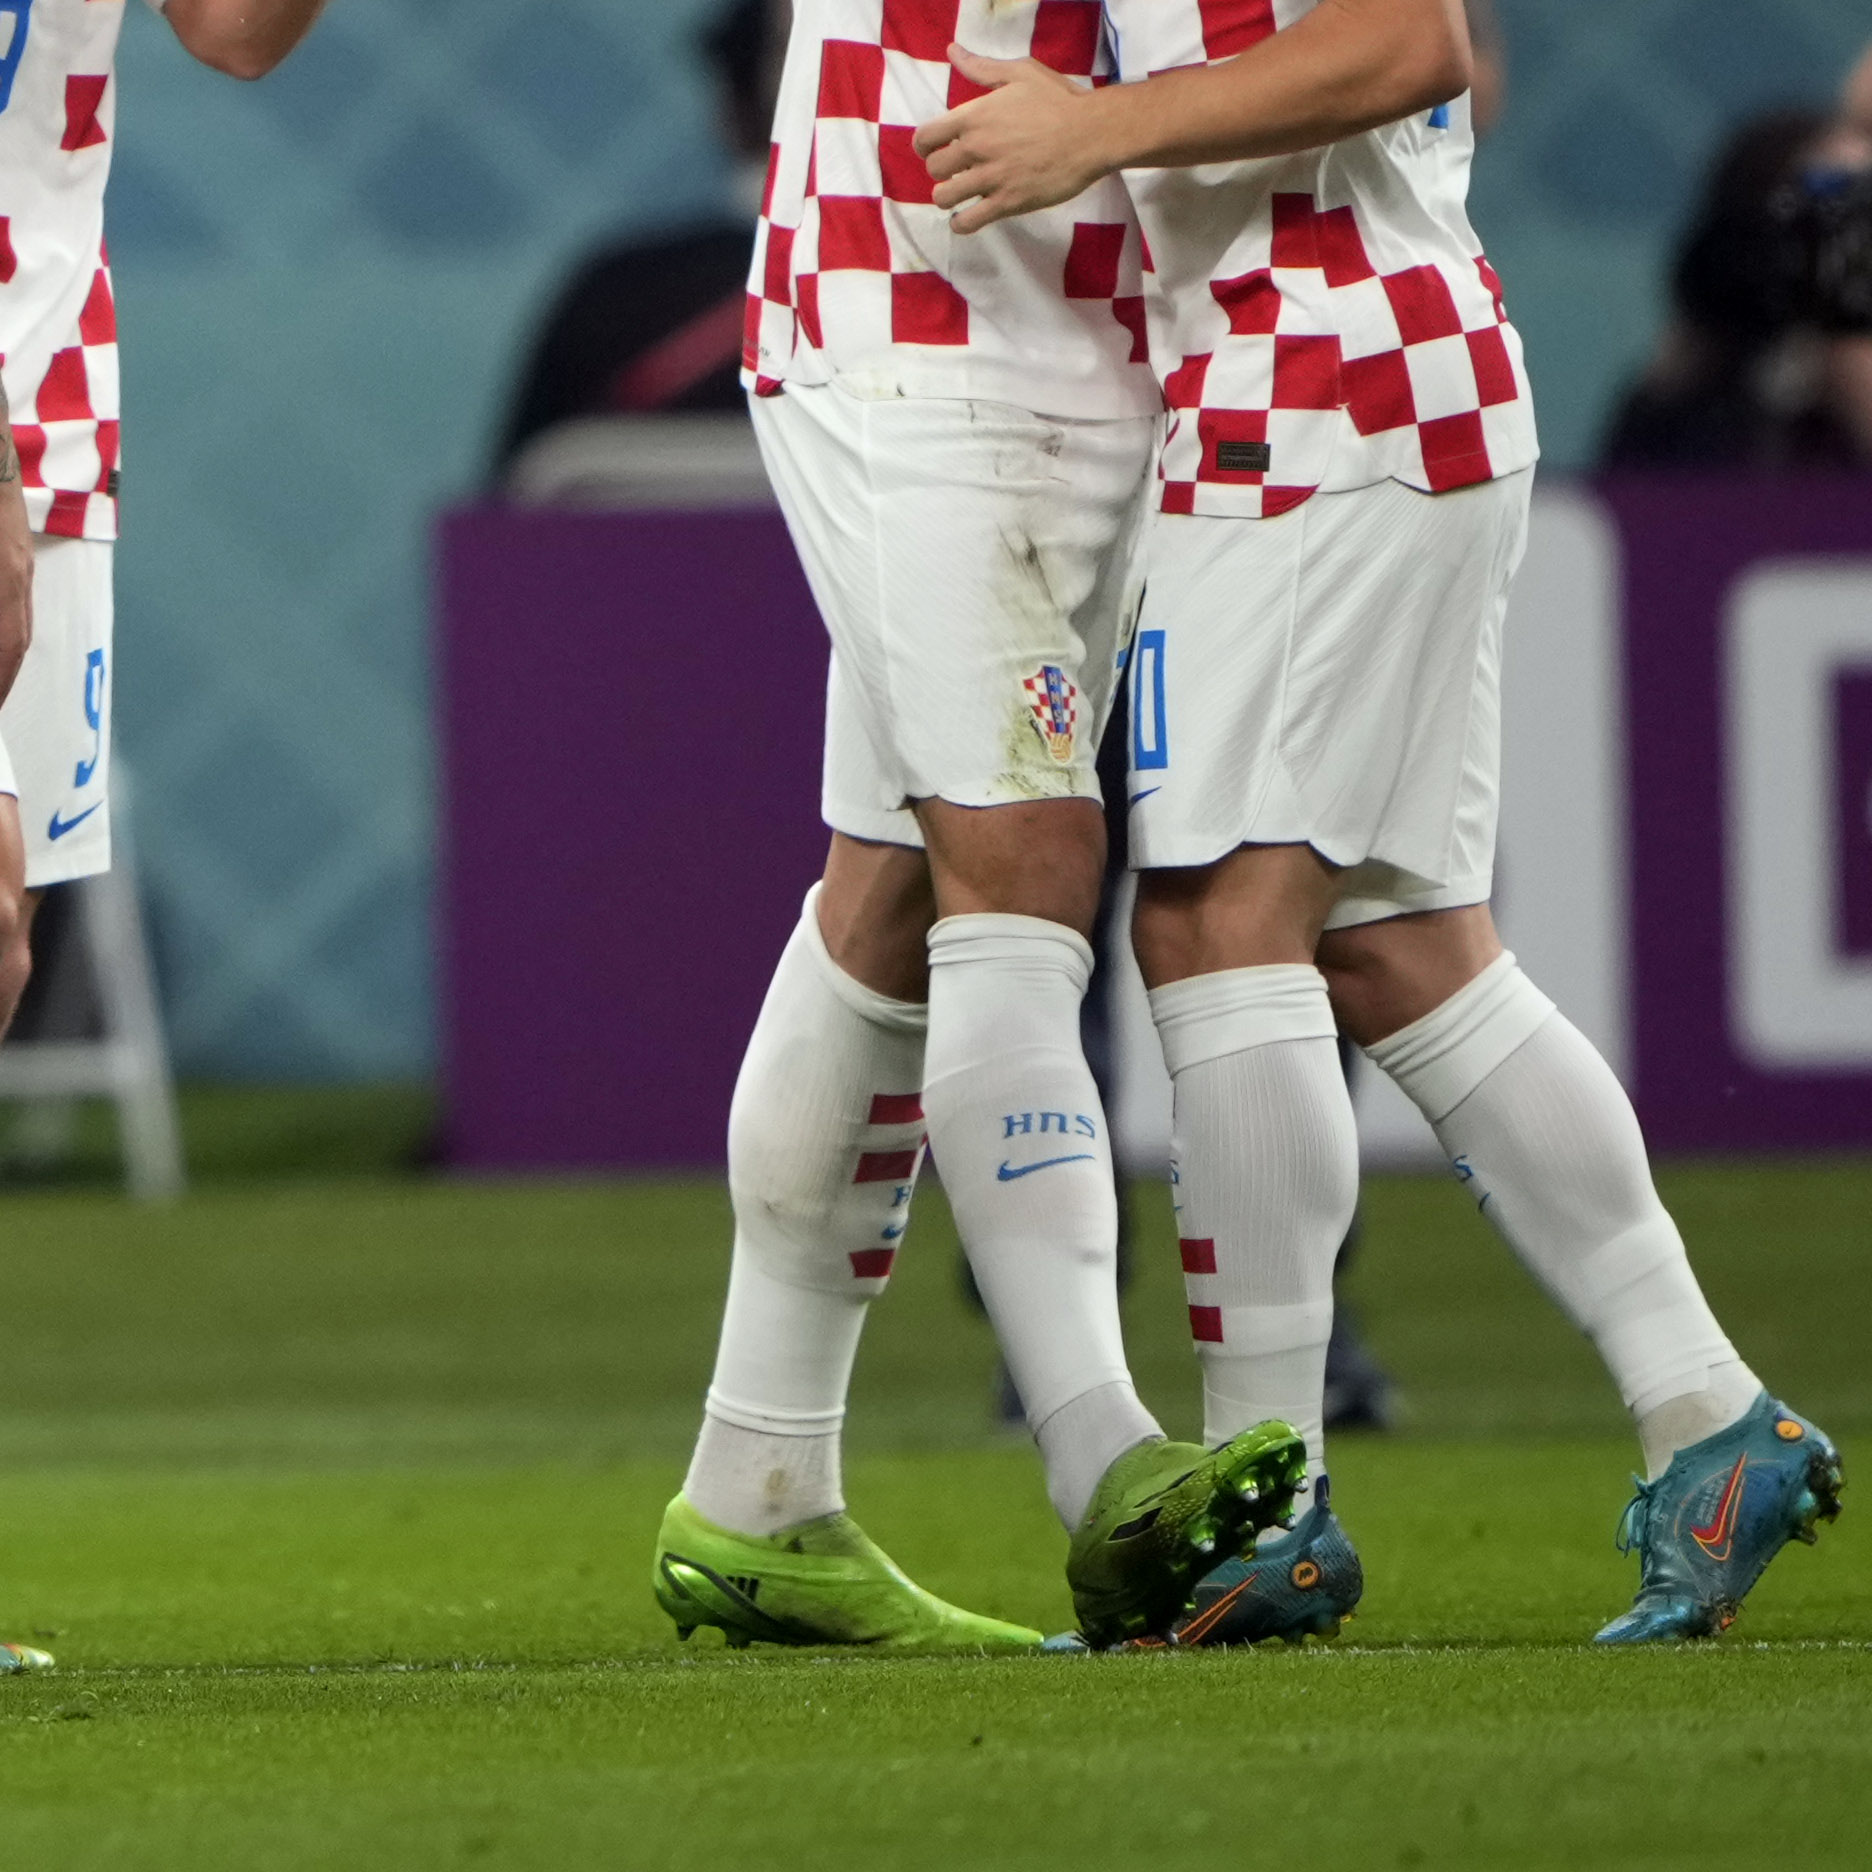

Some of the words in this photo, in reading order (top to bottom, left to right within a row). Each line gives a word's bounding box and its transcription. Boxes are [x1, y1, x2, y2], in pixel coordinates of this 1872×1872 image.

[74, 648, 105, 789] 9
[1134, 630, 1168, 770] 0
[1002, 1112, 1096, 1139] HNS
